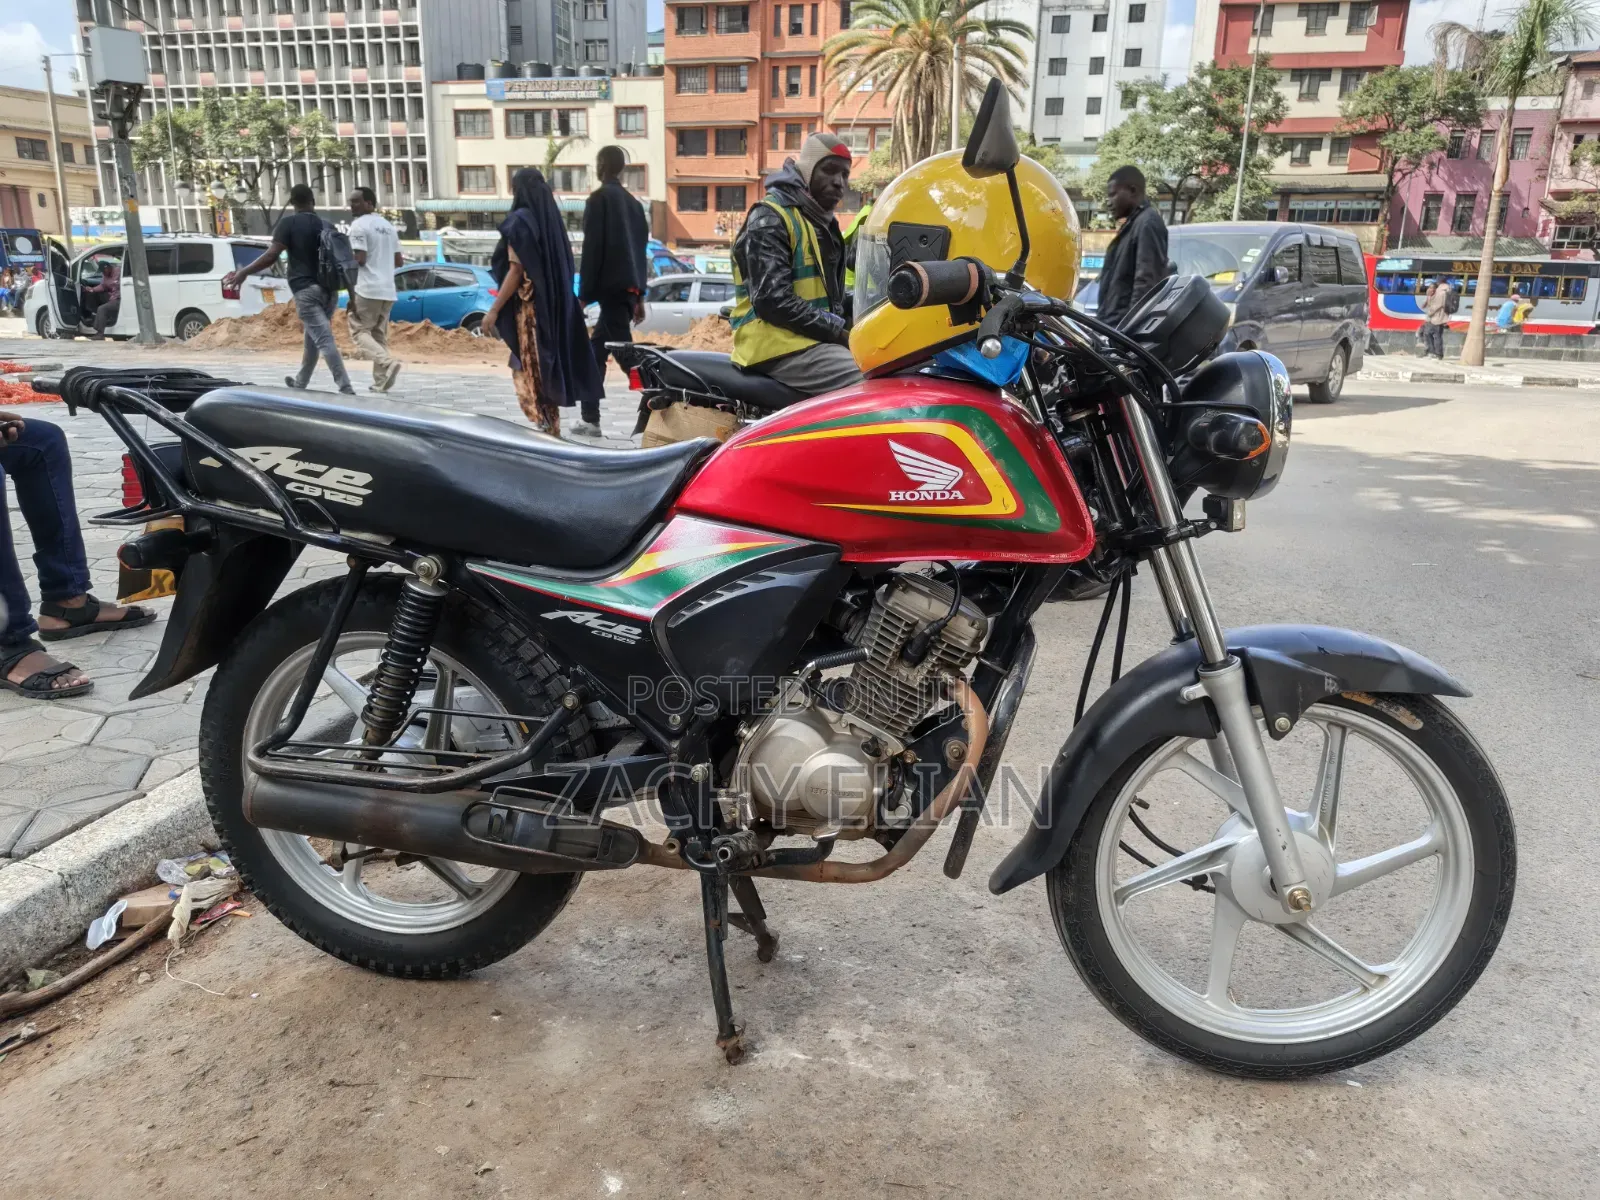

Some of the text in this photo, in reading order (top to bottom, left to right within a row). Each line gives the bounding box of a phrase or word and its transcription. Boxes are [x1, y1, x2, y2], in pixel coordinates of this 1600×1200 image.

[1509, 262, 1543, 274] DAY
[285, 481, 364, 507] CB125
[889, 490, 966, 501] HONDA
